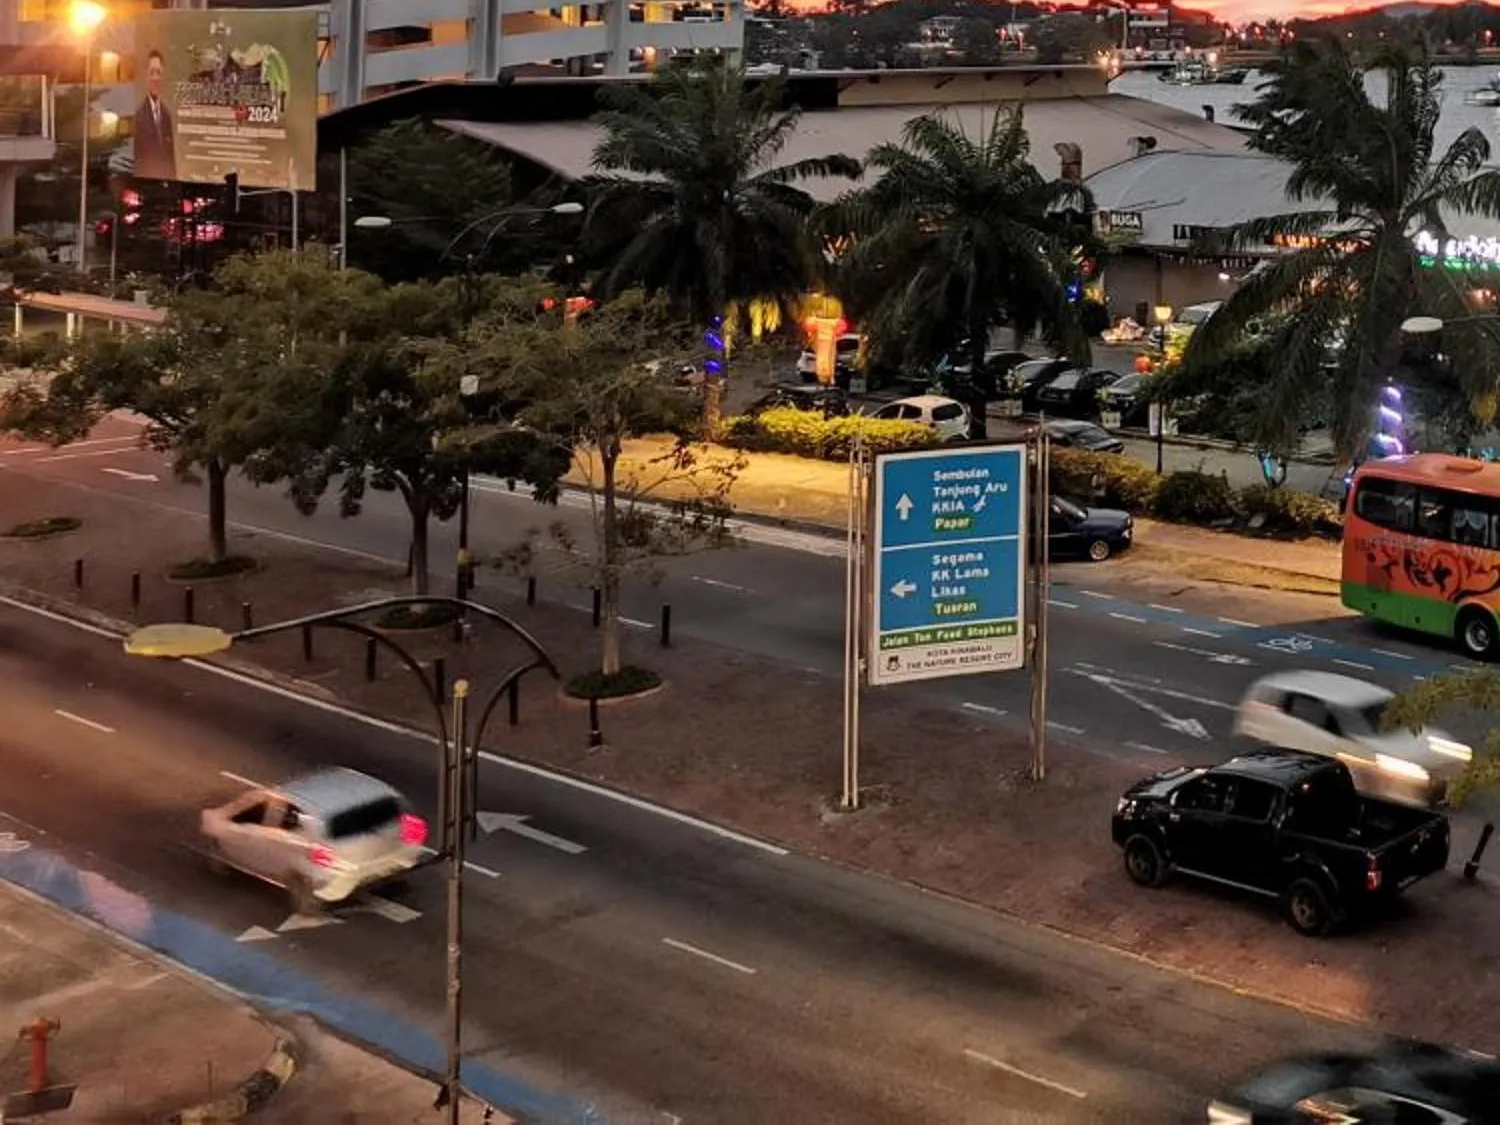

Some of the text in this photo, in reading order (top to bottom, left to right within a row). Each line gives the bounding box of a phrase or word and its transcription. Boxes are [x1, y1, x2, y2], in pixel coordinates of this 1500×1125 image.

[247, 106, 278, 123] 2024
[933, 467, 990, 481] Sembulan
[933, 482, 1008, 497] Tanjung Aru
[931, 499, 965, 513] KKIA
[935, 517, 970, 530] Papar
[931, 552, 984, 566] Segama
[931, 567, 990, 581] KK Lama
[931, 585, 966, 598] Likas
[934, 601, 978, 615] Tuaran
